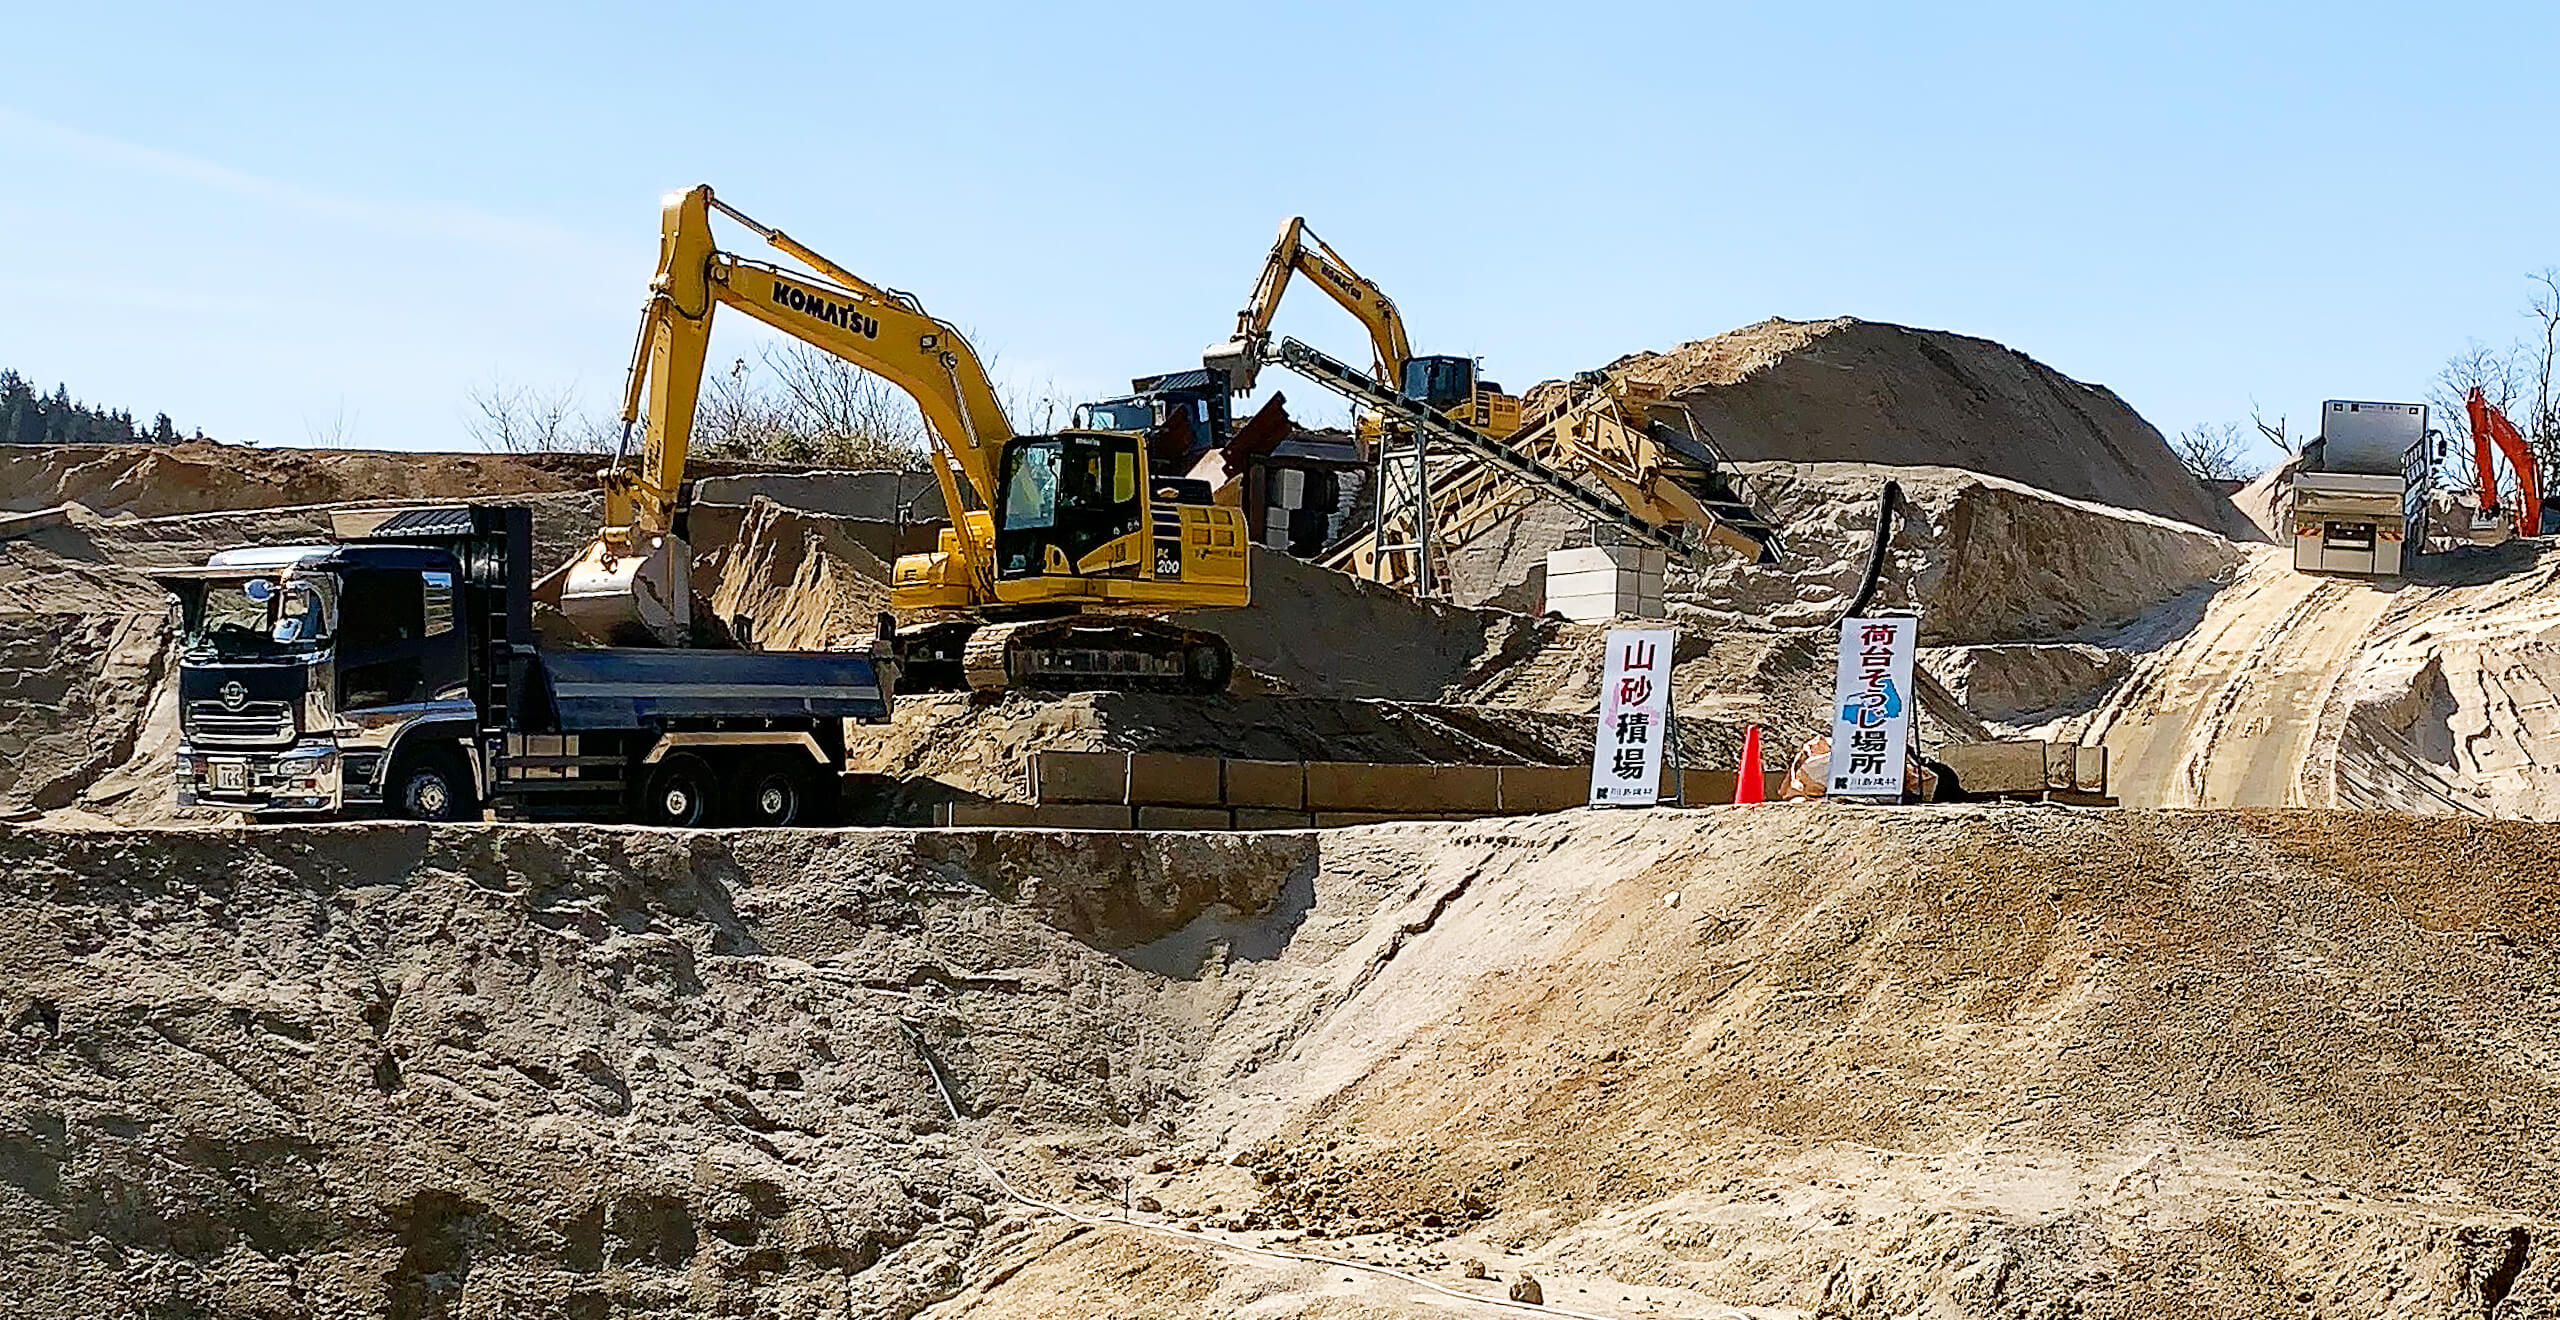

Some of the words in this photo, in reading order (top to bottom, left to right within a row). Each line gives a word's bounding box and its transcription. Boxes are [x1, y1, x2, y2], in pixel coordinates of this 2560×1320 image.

[772, 281, 879, 339] KOMATSU
[1156, 560, 1180, 573] 200
[1612, 639, 1656, 780] 山砂積場
[1848, 624, 1898, 775] 荷台そうじ場所
